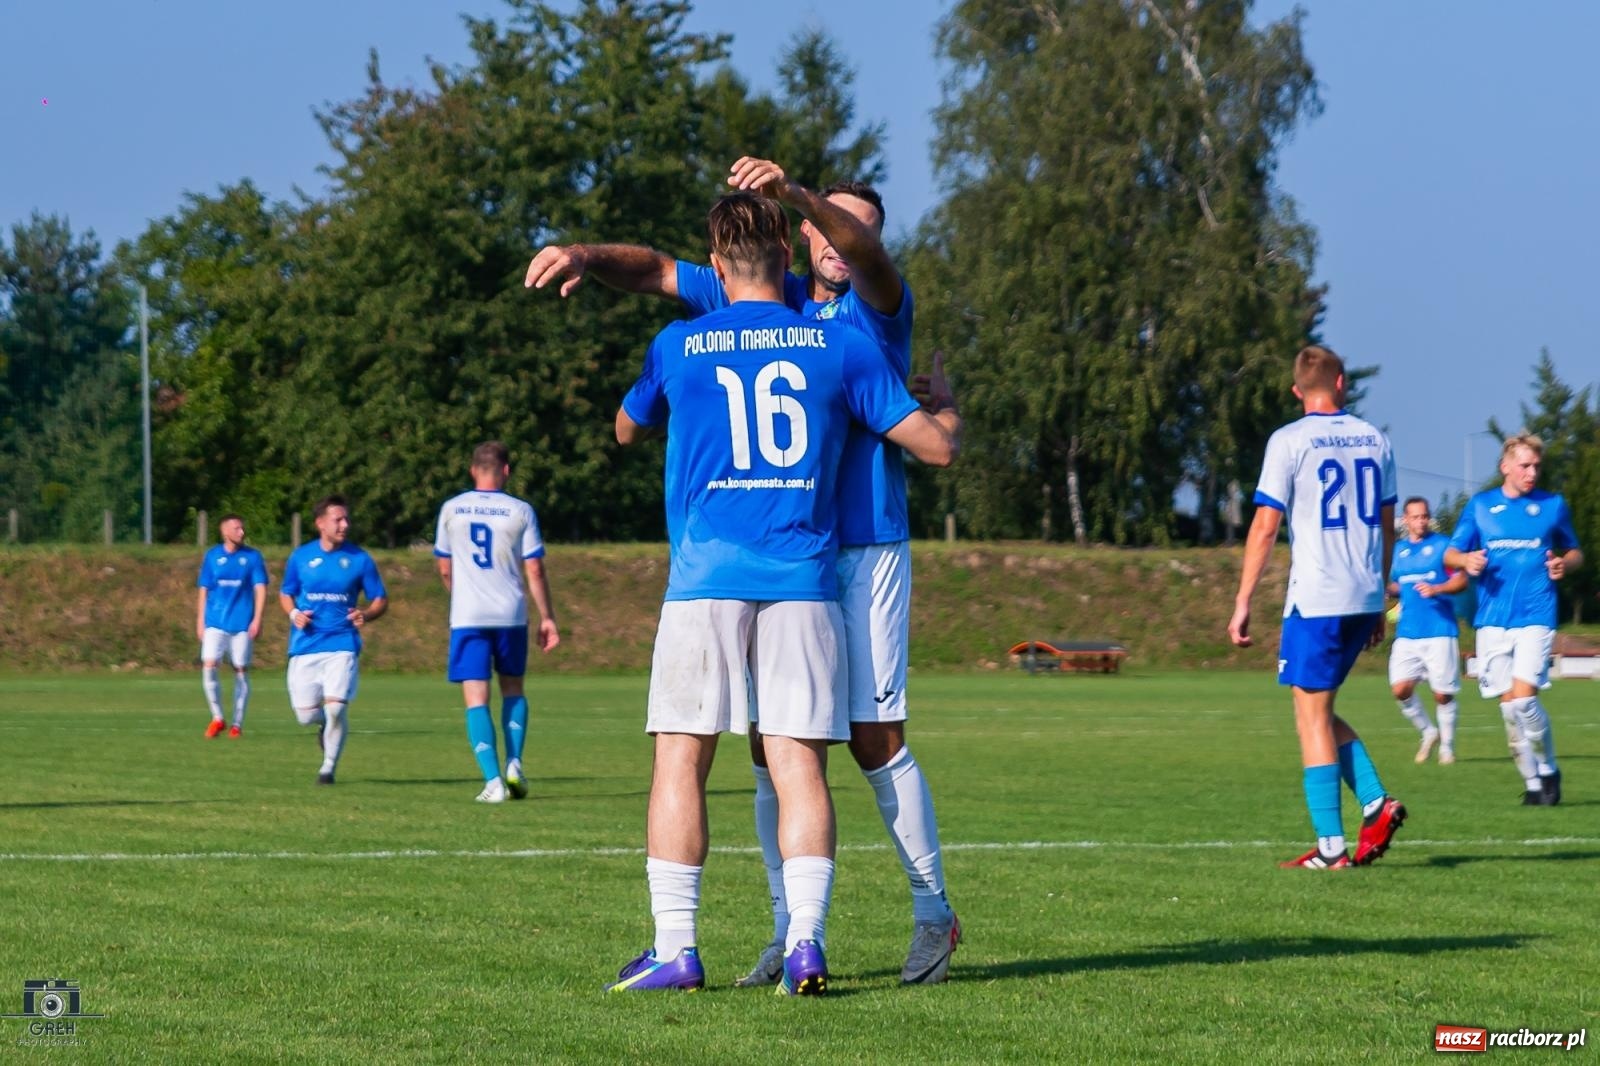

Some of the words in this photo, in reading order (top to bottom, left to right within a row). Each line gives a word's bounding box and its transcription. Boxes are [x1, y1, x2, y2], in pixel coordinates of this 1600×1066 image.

[684, 330, 736, 357] POLONIA
[740, 326, 827, 351] MARKLOWICE
[715, 360, 808, 470] 16
[1317, 457, 1383, 530] 20
[470, 522, 493, 569] 9
